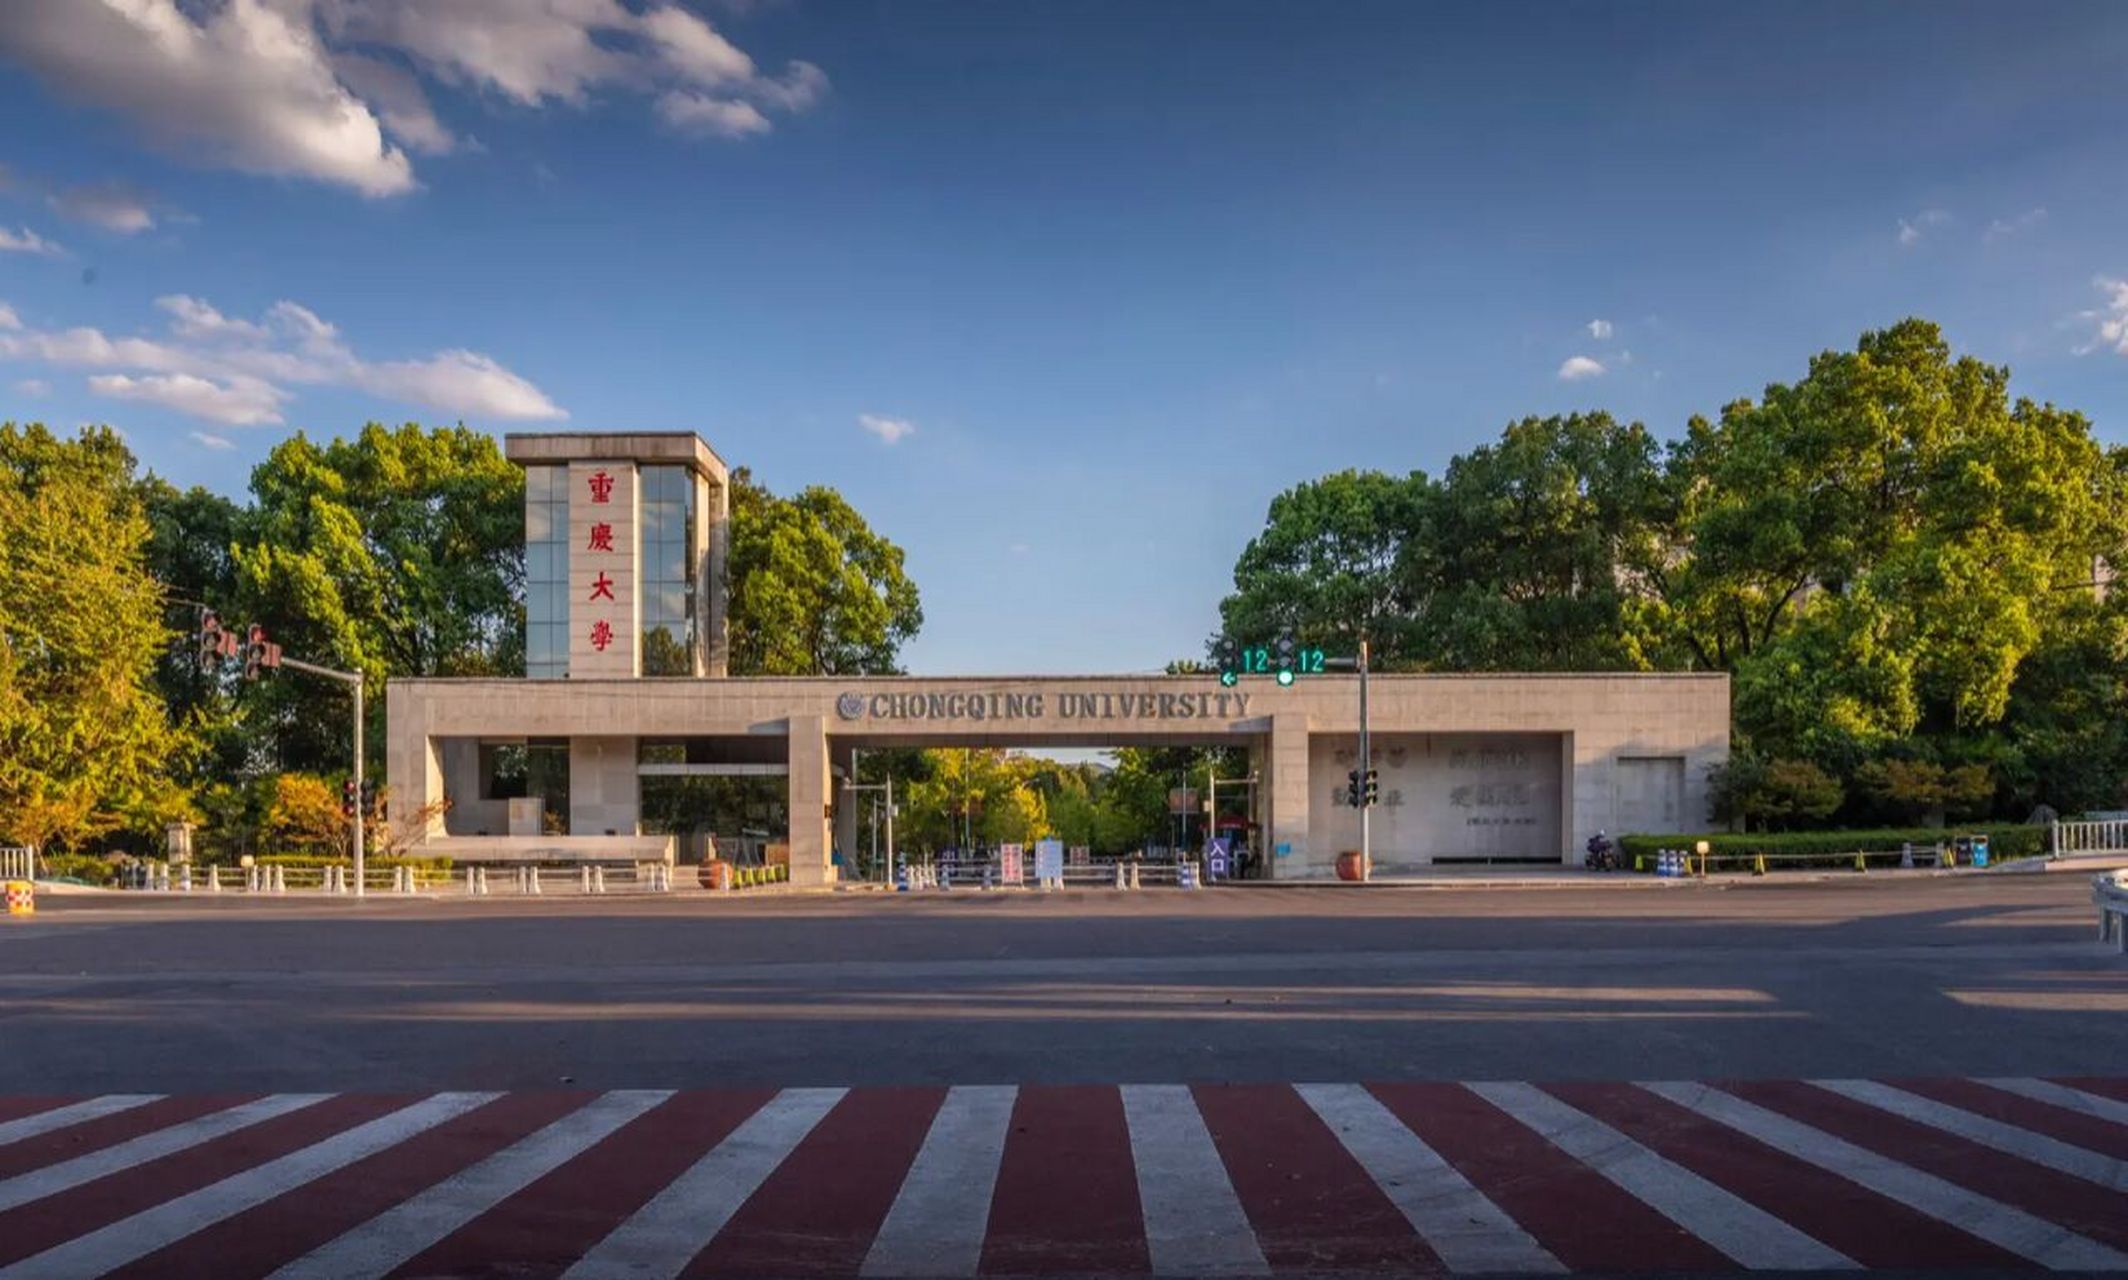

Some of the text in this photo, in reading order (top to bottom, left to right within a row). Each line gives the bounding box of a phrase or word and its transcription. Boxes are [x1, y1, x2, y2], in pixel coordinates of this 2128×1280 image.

[588, 472, 614, 651] 重慶大學
[1243, 650, 1267, 672] 12
[1302, 650, 1324, 672] 12
[870, 692, 1249, 720] CHONGQING UNIVERSITY
[1210, 841, 1225, 872] 入口
